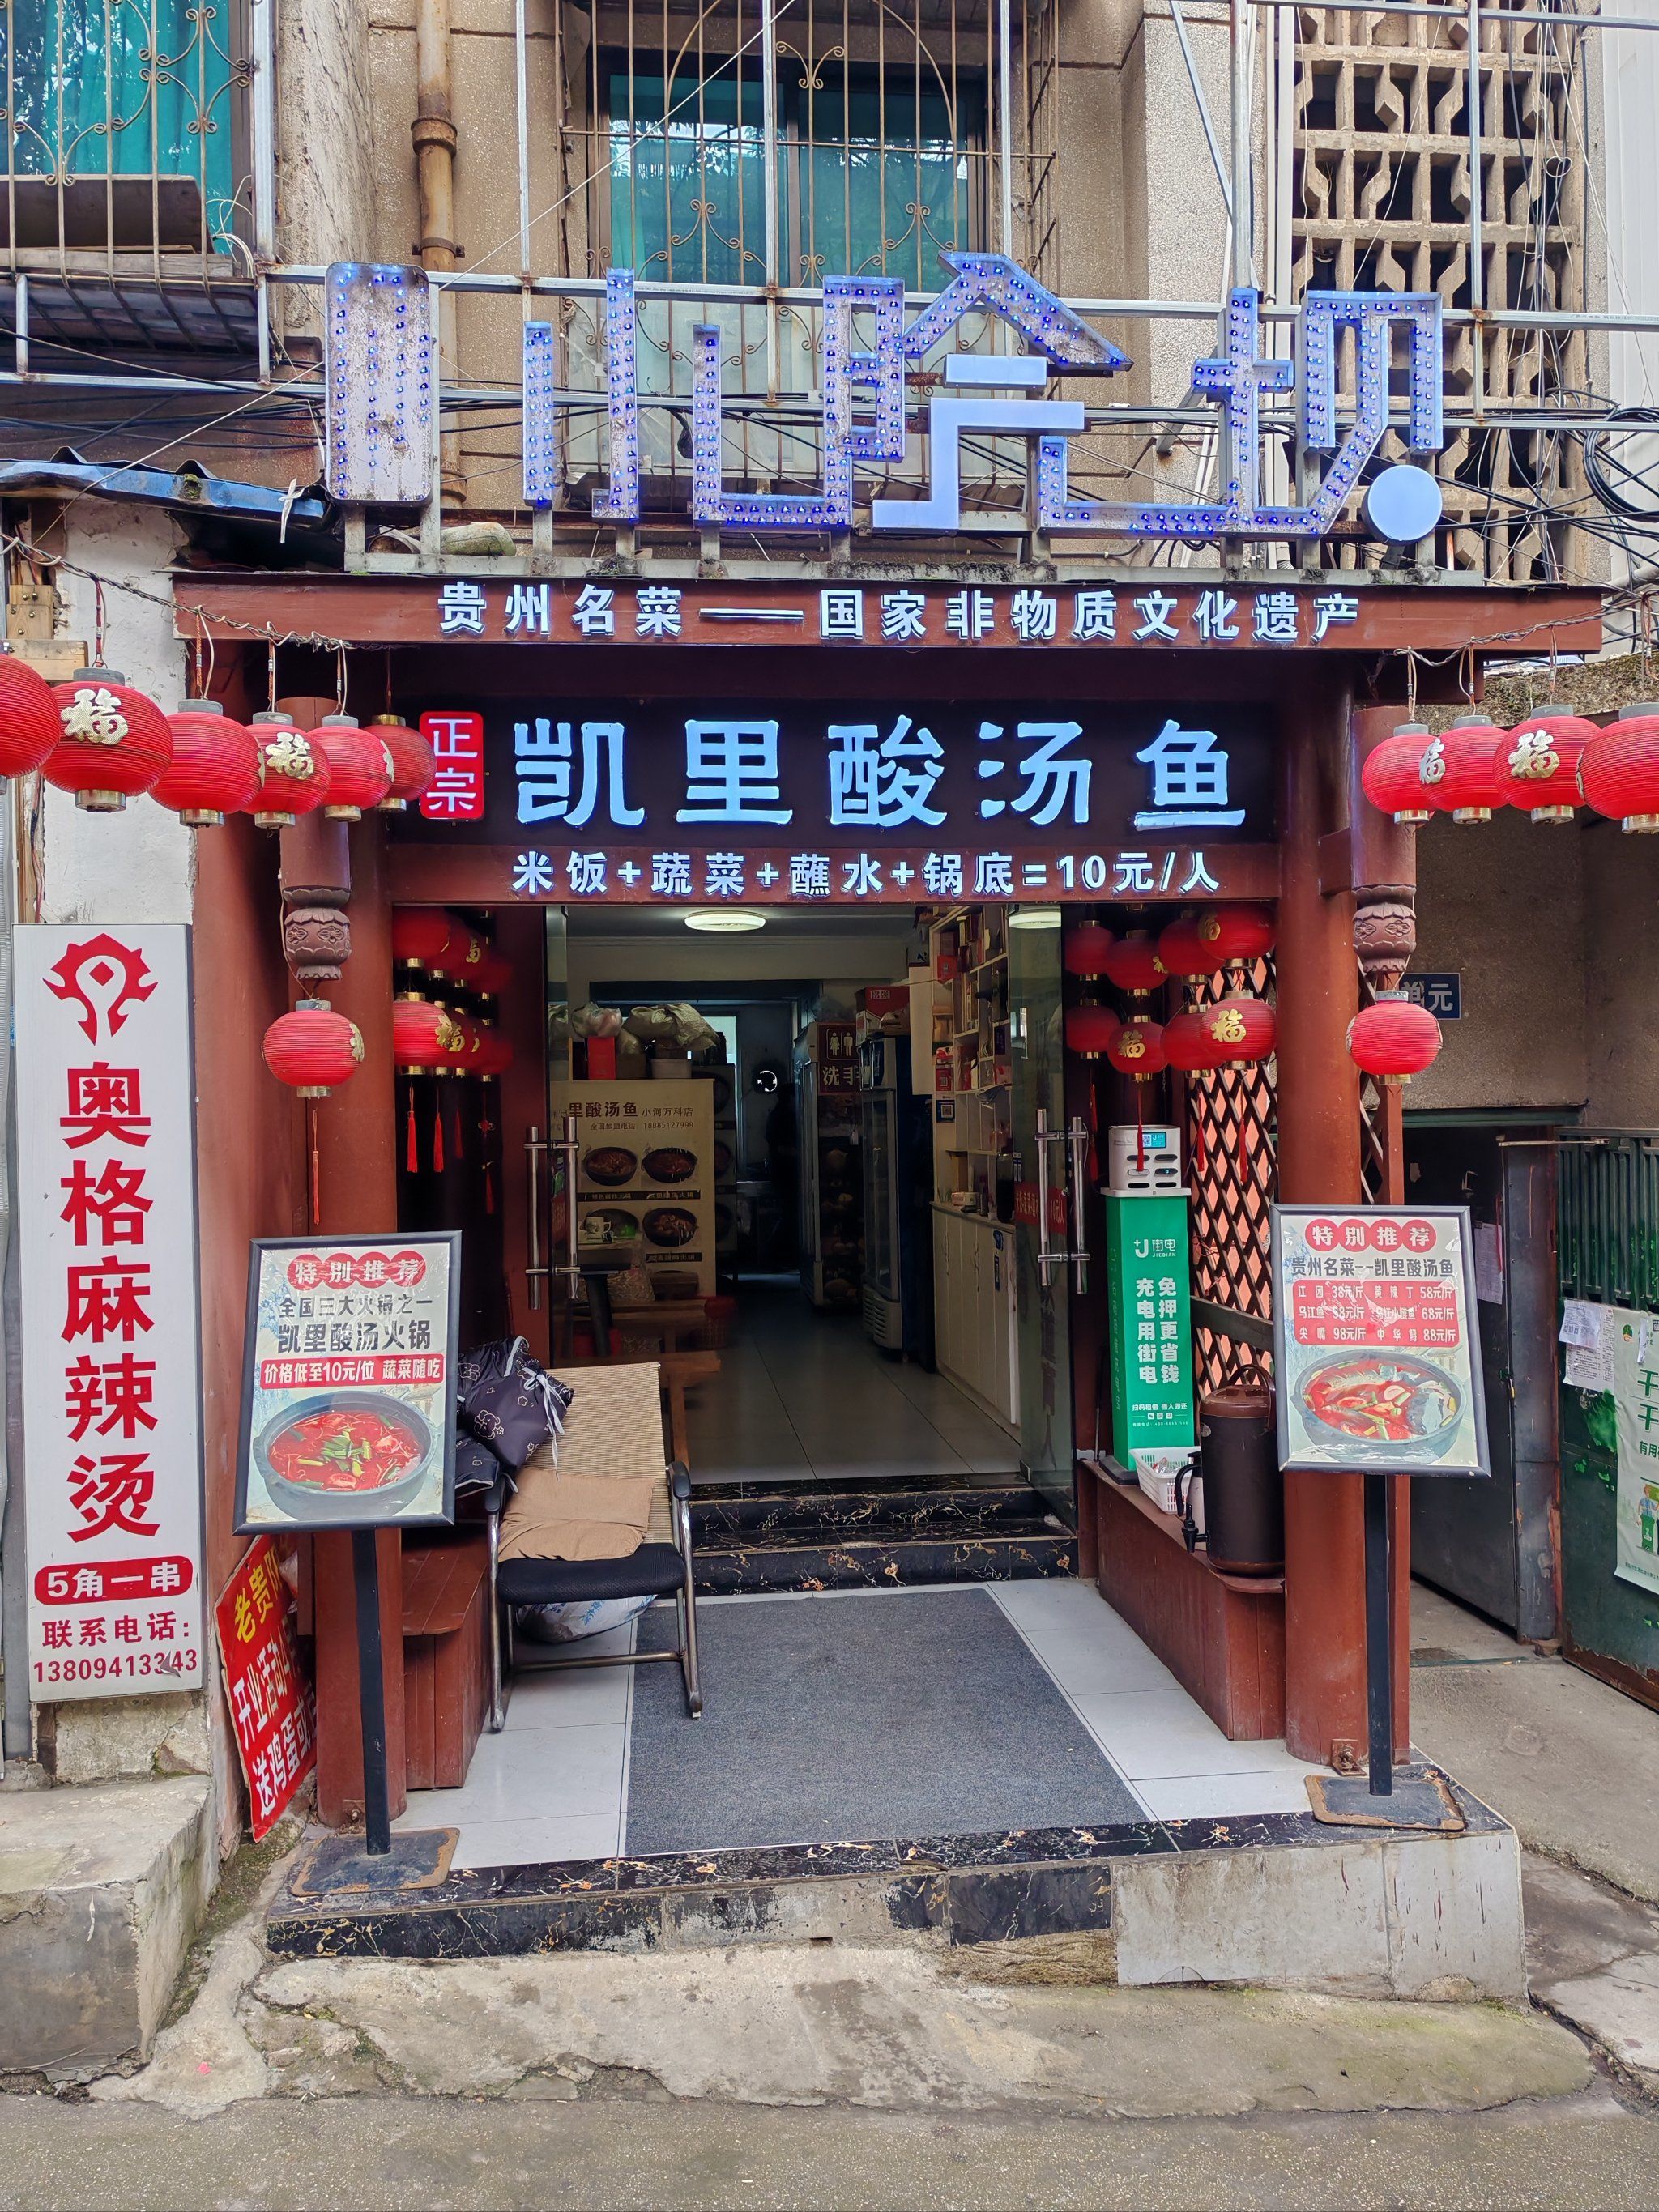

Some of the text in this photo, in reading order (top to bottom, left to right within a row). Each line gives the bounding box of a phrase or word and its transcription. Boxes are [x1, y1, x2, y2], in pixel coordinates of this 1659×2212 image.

[428, 717, 476, 812] 正宗
[513, 714, 1246, 831] 凯里酸汤鱼
[822, 1065, 860, 1086] 洗手
[1311, 1225, 1430, 1247] 特别推荐
[295, 1259, 420, 1285] 特别推荐
[59, 1061, 161, 1543] 奥格麻辣烫
[279, 1294, 433, 1318] 全国三大火锅之一
[1422, 1307, 1455, 1320] 68元/斤
[278, 1319, 431, 1354] 凯里酸汤火锅
[1136, 1278, 1158, 1385] 充电用街电
[1158, 1276, 1179, 1384] 免押更省钱
[1333, 1327, 1367, 1341] 98元/斤
[1423, 1328, 1456, 1343] 88元/斤
[264, 1357, 441, 1385] 价格低至10元/位 蔬菜随吃
[1639, 1440, 1659, 1459] 有用
[46, 1562, 182, 1599] 5角一串
[42, 1610, 190, 1649] 联系电话:
[33, 1648, 198, 1684] 13809413343
